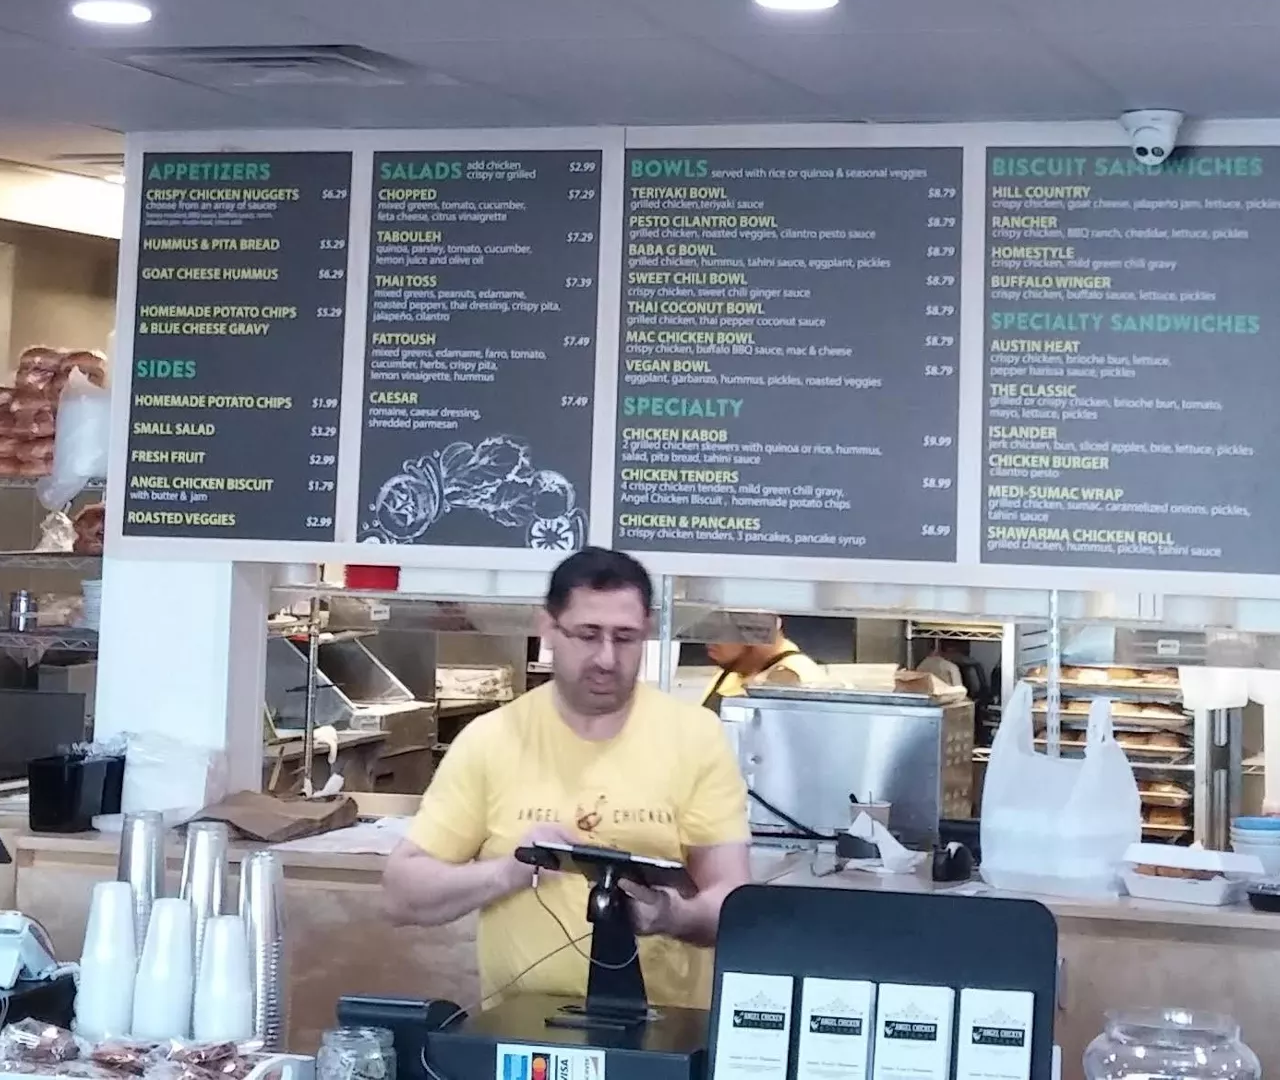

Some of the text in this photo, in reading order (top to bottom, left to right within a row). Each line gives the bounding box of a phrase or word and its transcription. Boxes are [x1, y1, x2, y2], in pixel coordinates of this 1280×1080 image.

[380, 162, 462, 180] SALADS
[467, 161, 521, 170] add chicken
[569, 162, 595, 172] $2.99
[631, 160, 708, 178] BOWLS
[992, 158, 1264, 176] BISCUIT SANDWICHES
[148, 163, 271, 181] APPETIZERS
[466, 170, 537, 180] crispy or grilled
[146, 189, 300, 200] CRISPY CHICKEN NUGGETS
[378, 189, 437, 200] CHOPPED
[568, 190, 594, 200] $7.29
[631, 188, 727, 199] TERIYAKI BOWL
[993, 187, 1090, 198] HILL COUNTRY
[630, 216, 778, 227] PESTO CILANTRO BOWL
[993, 217, 1057, 228] RANCHER
[377, 231, 441, 242] TABOULEH
[567, 232, 593, 243] $7.29
[144, 239, 280, 250] HUMMUS & PITA BREAD
[629, 244, 717, 255] BABA G BOWL
[992, 247, 1075, 258] HOMESTYLE
[376, 256, 484, 265] lemon juice and olive oil
[143, 268, 279, 280] GOAT CHEESE HUMMUS
[629, 273, 748, 284] SWEET CHILI BOWL
[376, 276, 437, 287] THAI TOSS
[565, 278, 592, 288] $7.39
[991, 276, 1111, 288] BUFFALO WINGER
[140, 306, 297, 319] HOMEMADE POTATO CHIPS
[627, 302, 765, 314] THAI COCONUT BOWL
[140, 323, 270, 335] & BLUE CHEESE GRAVY
[991, 313, 1260, 334] SPECIALTY SANDWICHES
[372, 333, 436, 346] FATTOUSH
[564, 336, 590, 347] $7.49
[626, 332, 755, 344] MAC CHICKEN BOWL
[991, 340, 1080, 353] AUSTIN HEAT
[137, 360, 196, 378] SIDES
[626, 360, 712, 372] VEGAN BOWL
[990, 384, 1077, 397] THE CLASSIC
[135, 395, 292, 409] HOMEMADE POTATO CHIPS
[312, 398, 338, 408] $1.99
[370, 392, 418, 404] CAESAR
[561, 396, 588, 407] $7.49
[624, 398, 743, 417] SPECIALTY
[134, 423, 215, 435] SMALL SALAD
[989, 426, 1057, 438] ISLANDER
[623, 429, 728, 442] CHICKEN KABOB
[132, 451, 206, 463] FRESH FRUIT
[989, 455, 1109, 469] CHICKEN BURGER
[621, 470, 739, 483] CHICKEN TENDERS
[131, 477, 273, 491] ANGEL CHICKEN BISCUIT
[130, 492, 149, 500] with
[152, 492, 179, 501] butter
[191, 492, 207, 502] jam
[989, 486, 1123, 500] MEDI-SUMAC WRAP
[128, 512, 236, 526] ROASTED VEGGIES
[620, 515, 761, 530] CHICKEN & PANCAKES
[988, 527, 1175, 544] SHAWARMA CHICKEN ROLL
[518, 808, 560, 822] ANGEL
